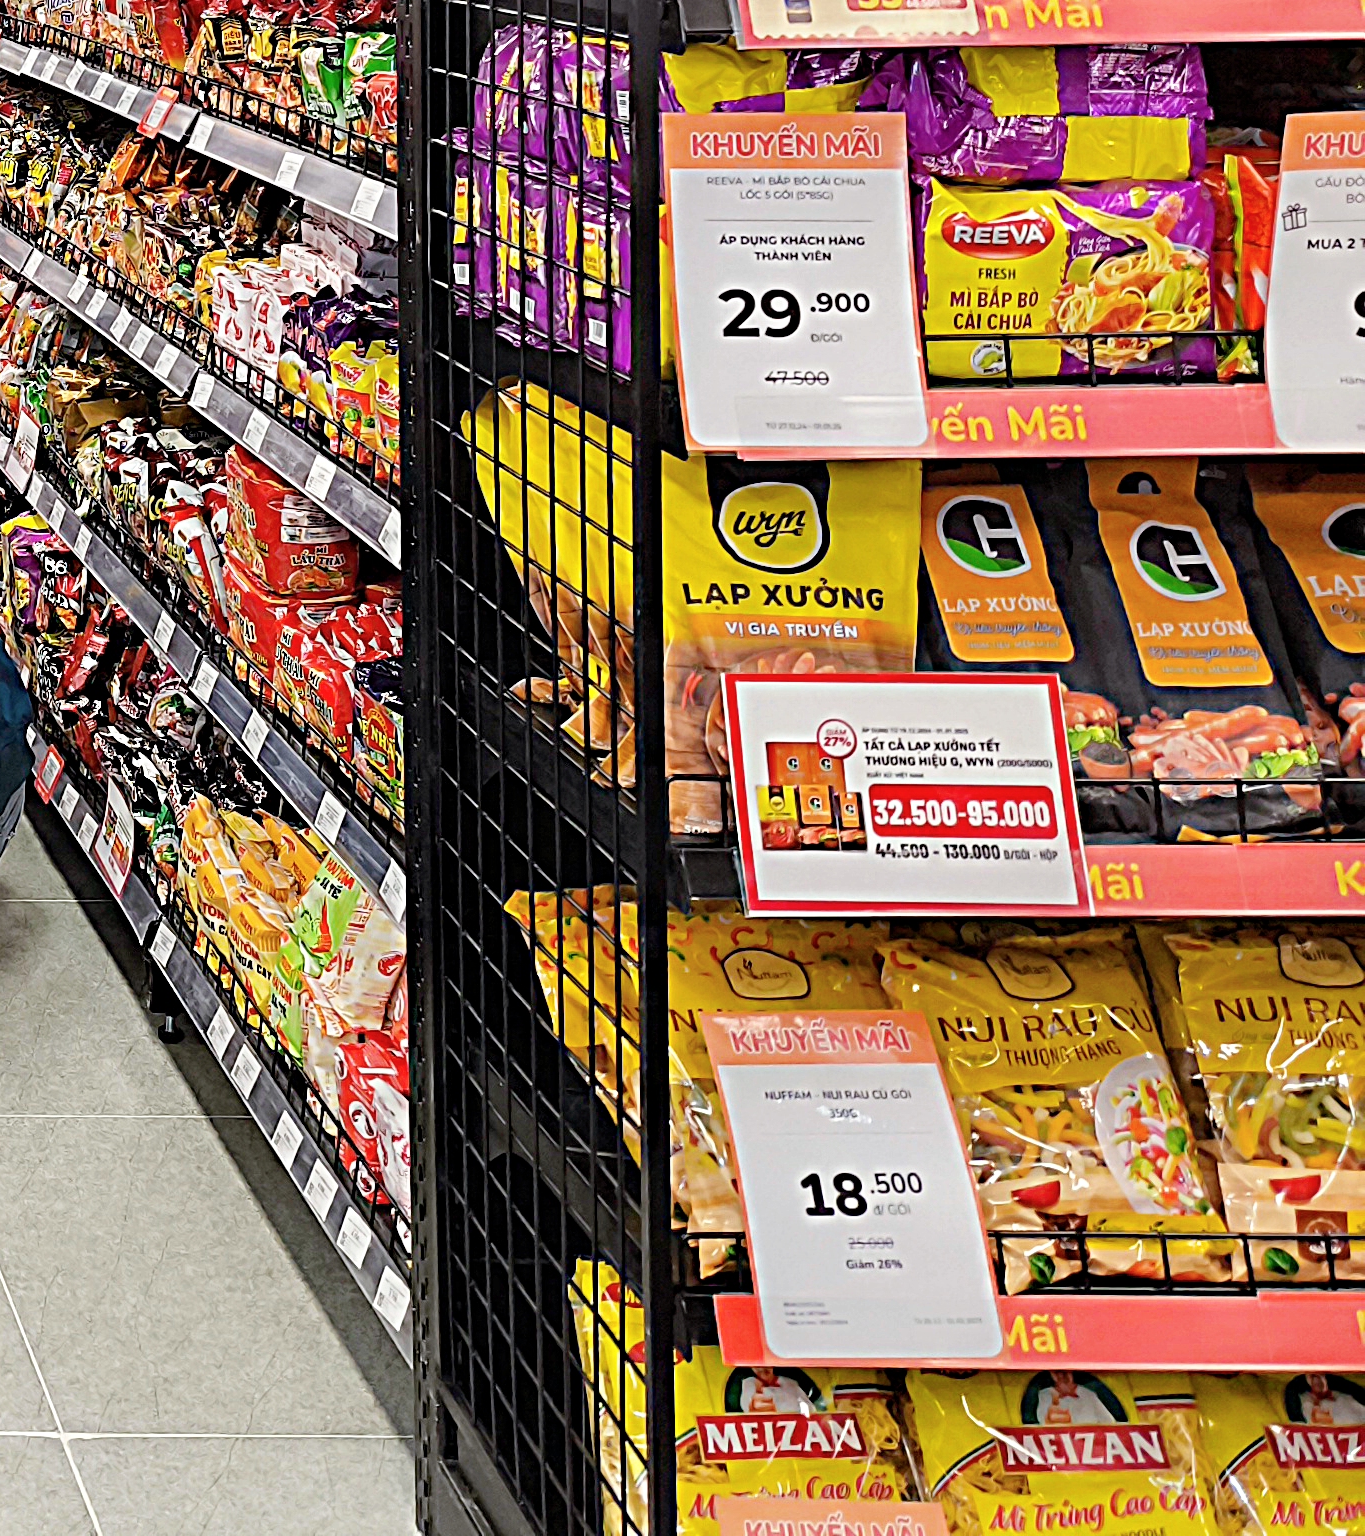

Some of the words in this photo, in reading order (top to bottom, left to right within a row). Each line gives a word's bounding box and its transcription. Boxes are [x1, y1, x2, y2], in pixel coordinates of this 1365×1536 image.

[691, 122, 817, 158] KHUYẾN
[825, 125, 881, 158] MÃI
[719, 234, 737, 245] ÁP
[741, 236, 777, 248] DỤNG
[781, 234, 825, 246] KHÁCH
[829, 234, 865, 246] HÀNG
[950, 220, 1048, 248] REEVA
[755, 249, 799, 261] THÀNH
[803, 250, 831, 261] VIÊN
[978, 267, 1017, 281] FRESH
[719, 288, 801, 338] 29
[810, 292, 871, 313] .900
[731, 503, 805, 549] wyn
[319, 555, 346, 566] THÁI
[681, 582, 751, 612] LẠP
[761, 577, 885, 612] XƯỞNG
[724, 621, 745, 639] VỊ
[747, 621, 780, 638] GIA
[785, 619, 858, 639] TRUYỀN
[863, 738, 884, 751] TẤT
[888, 738, 905, 751] CẢ
[908, 742, 930, 754] LẠP
[979, 738, 1000, 752] TẾT
[872, 799, 1051, 828] 32.500-95.000
[800, 1172, 868, 1217] 18
[870, 1172, 923, 1194] .500
[1002, 1430, 1167, 1469] MEIZAN
